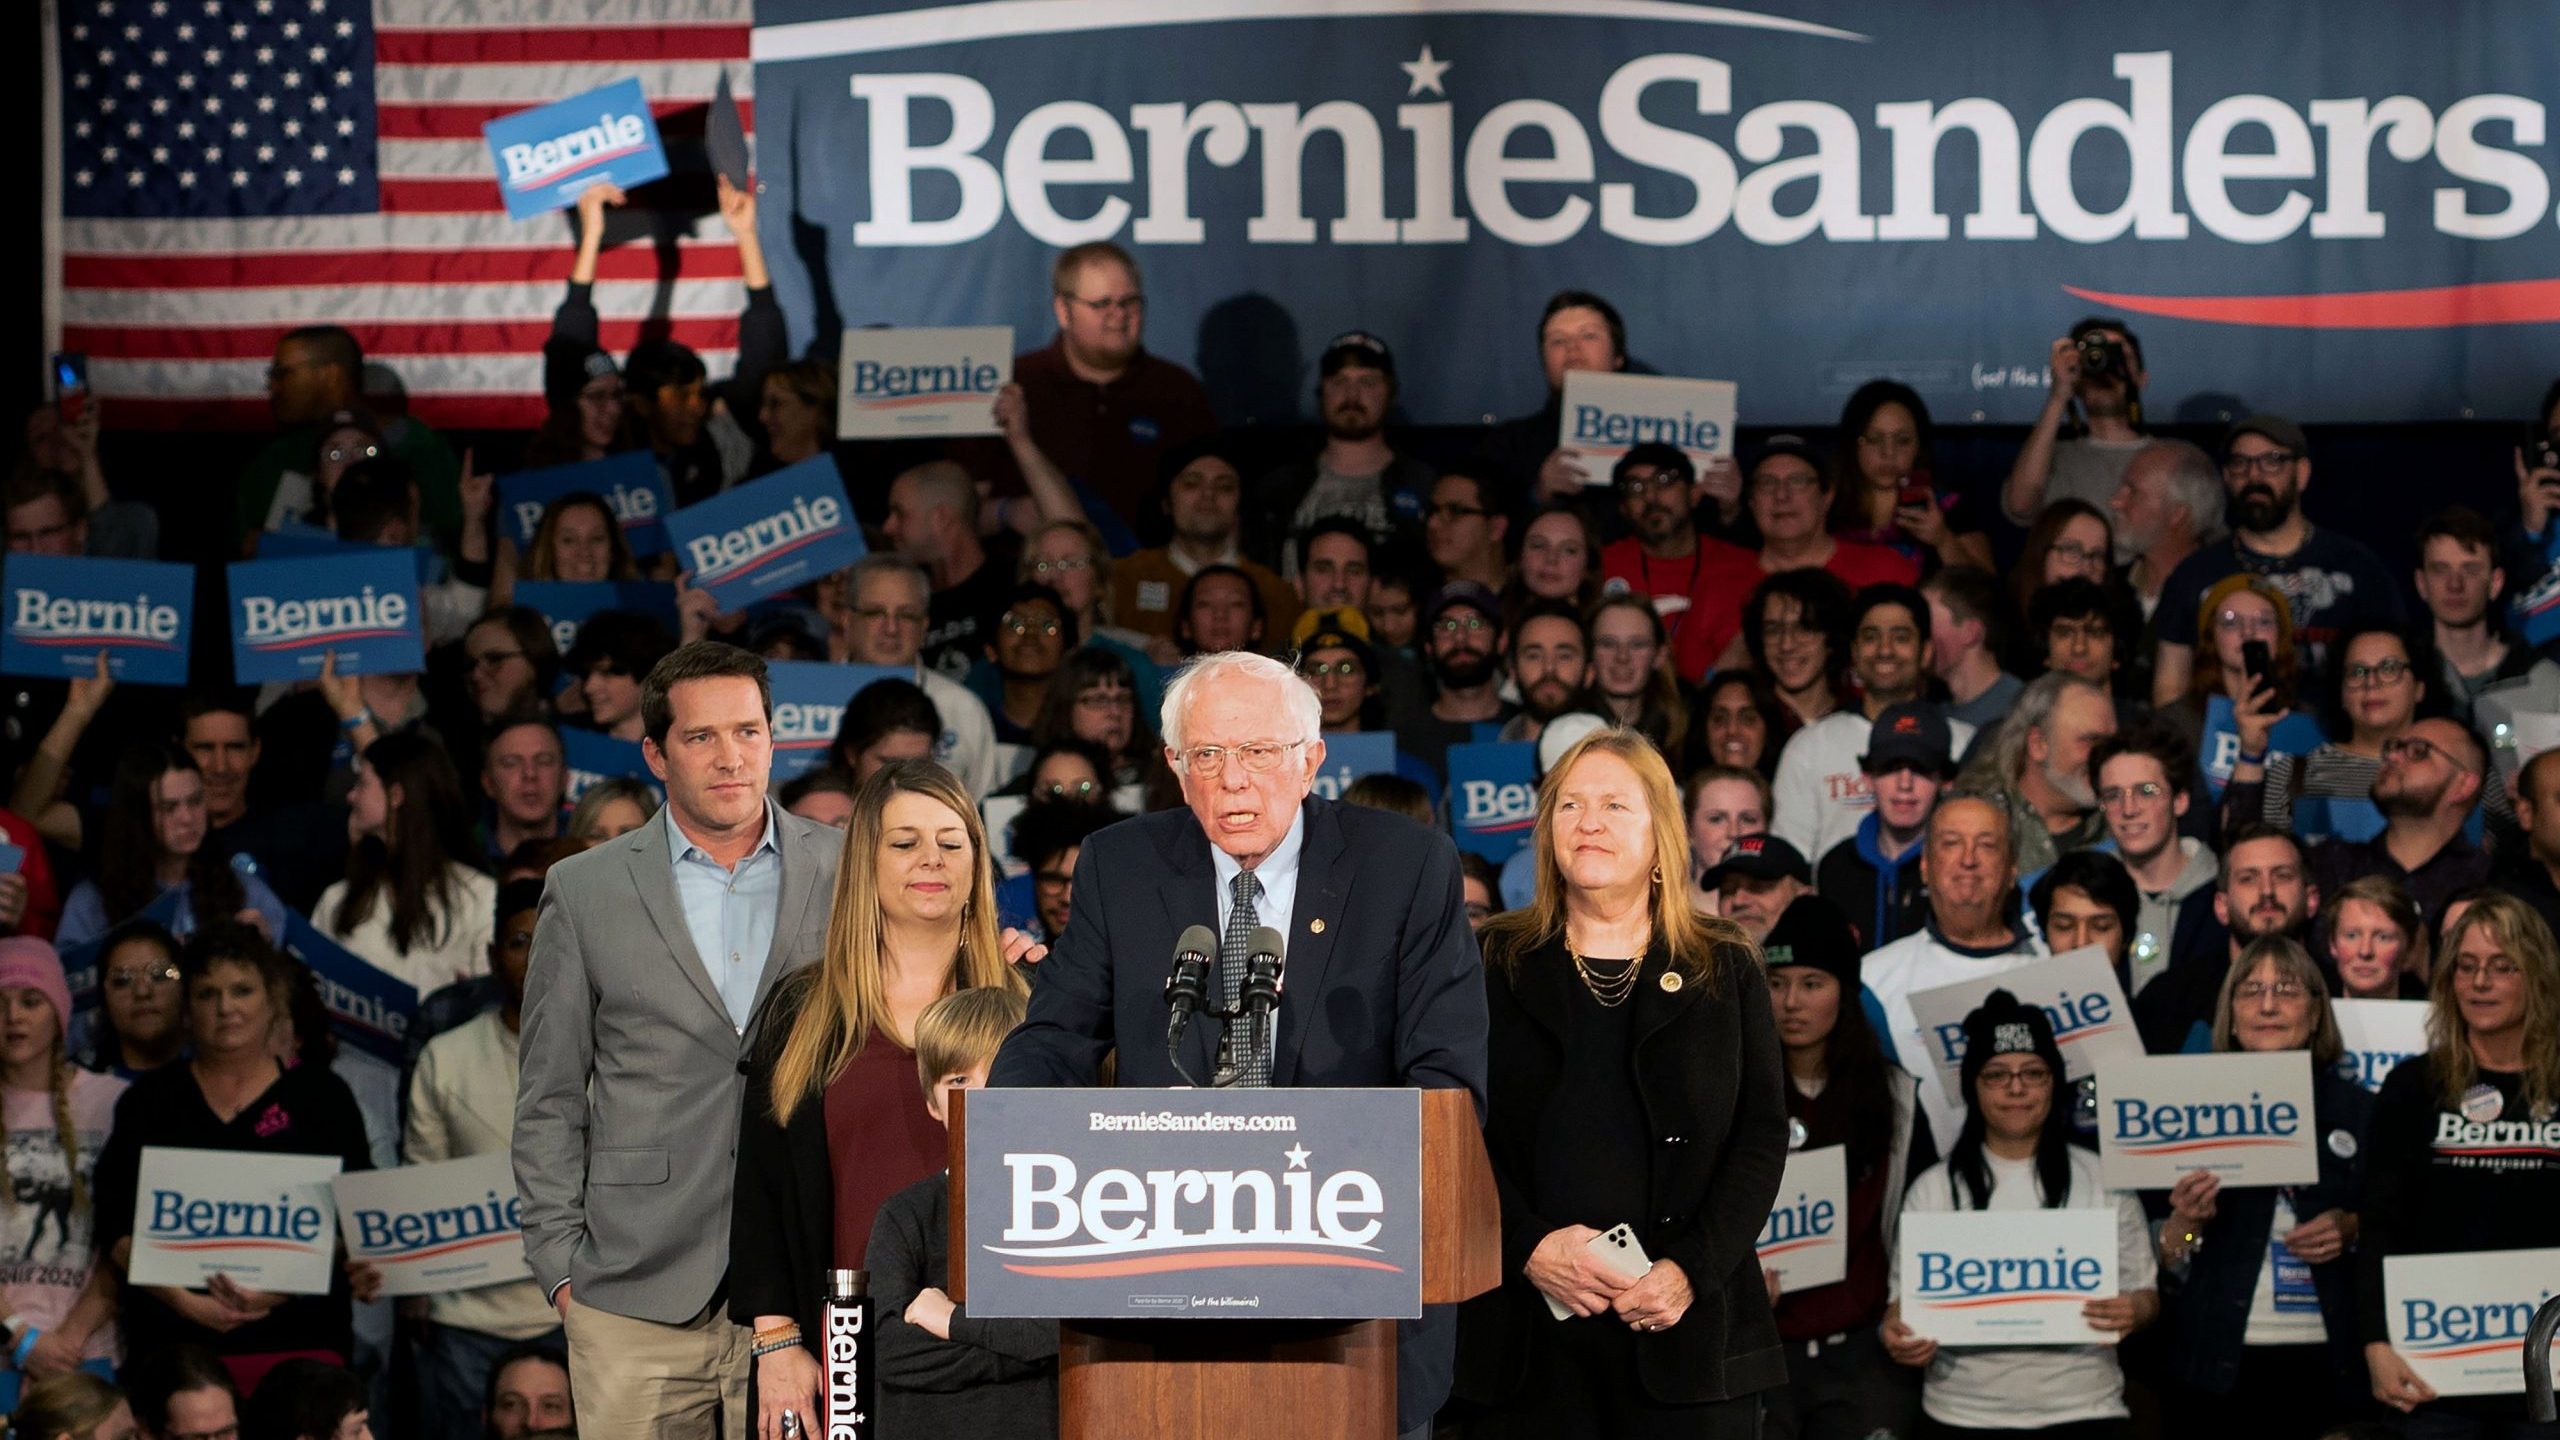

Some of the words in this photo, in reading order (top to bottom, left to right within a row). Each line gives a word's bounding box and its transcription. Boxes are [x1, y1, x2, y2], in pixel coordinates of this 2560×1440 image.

[502, 113, 646, 185] Bernie
[850, 45, 2560, 246] BernieSanders
[854, 356, 998, 396] Bernie
[1575, 404, 1720, 450] Bernie
[686, 495, 842, 576] Bernie
[14, 588, 179, 641] Bernie
[241, 585, 407, 637] Bernie
[1089, 1111, 1297, 1131] BernieSanders.com
[2112, 1091, 2298, 1142] Bernie
[2435, 1110, 2560, 1149] Bernie
[151, 1189, 320, 1242] Bernie
[1003, 1142, 1384, 1246] Bernie
[1769, 1193, 1835, 1242] nie
[353, 1190, 521, 1251] Bernie
[1917, 1247, 2101, 1293] Bernie
[829, 1304, 866, 1440] Bernie
